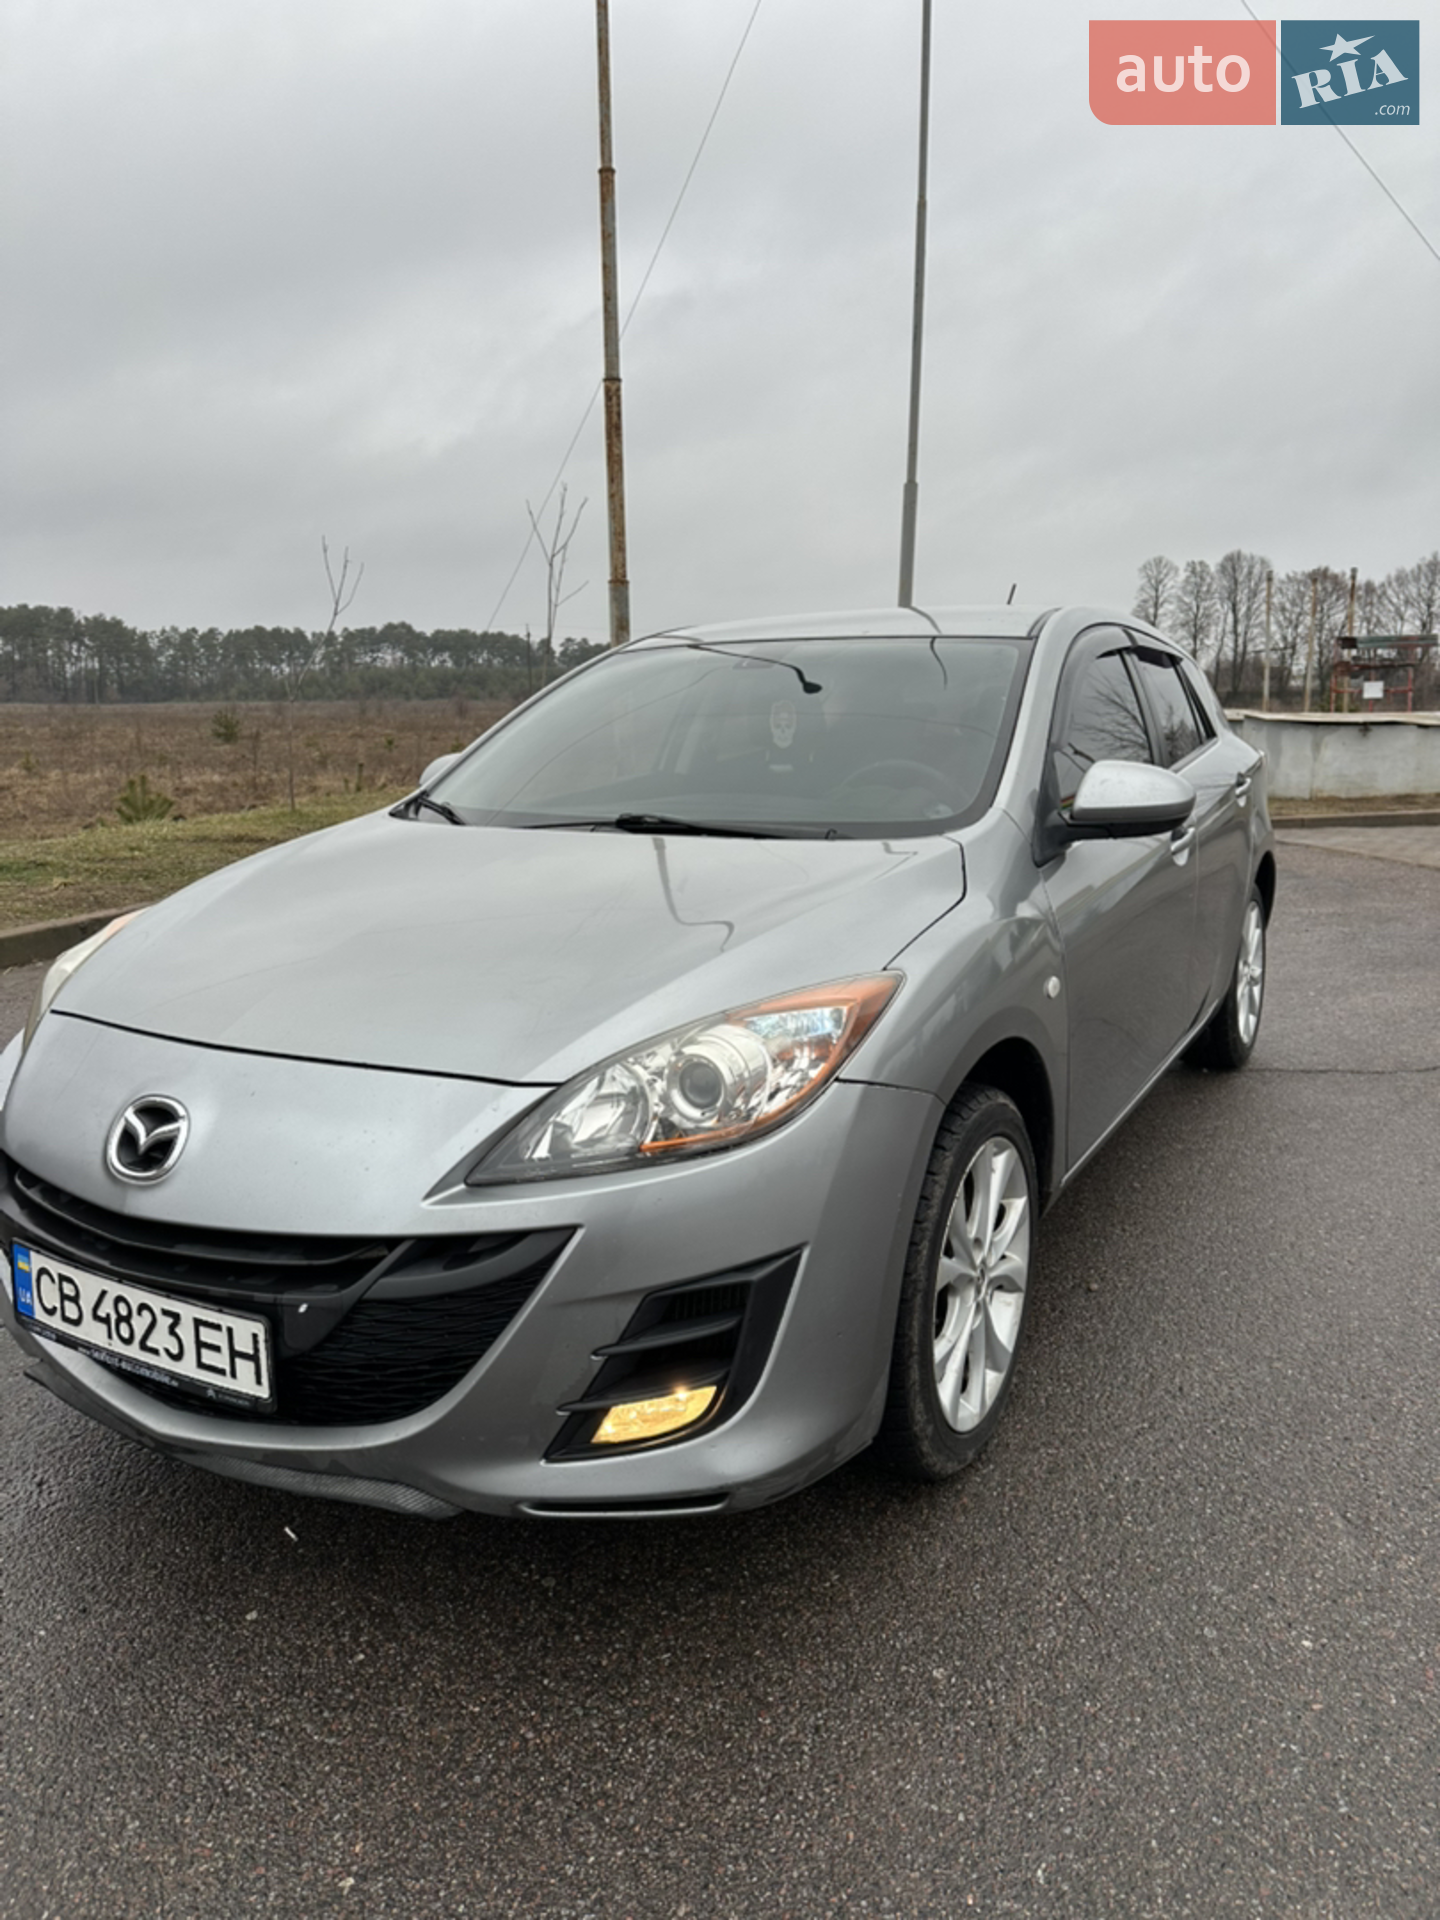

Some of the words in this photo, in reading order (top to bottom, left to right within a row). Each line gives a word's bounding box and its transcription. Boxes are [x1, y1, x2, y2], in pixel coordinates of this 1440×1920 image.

[19, 1286, 33, 1306] UA
[36, 1266, 84, 1327] CB
[91, 1289, 184, 1362] 4823
[192, 1317, 262, 1387] EH
